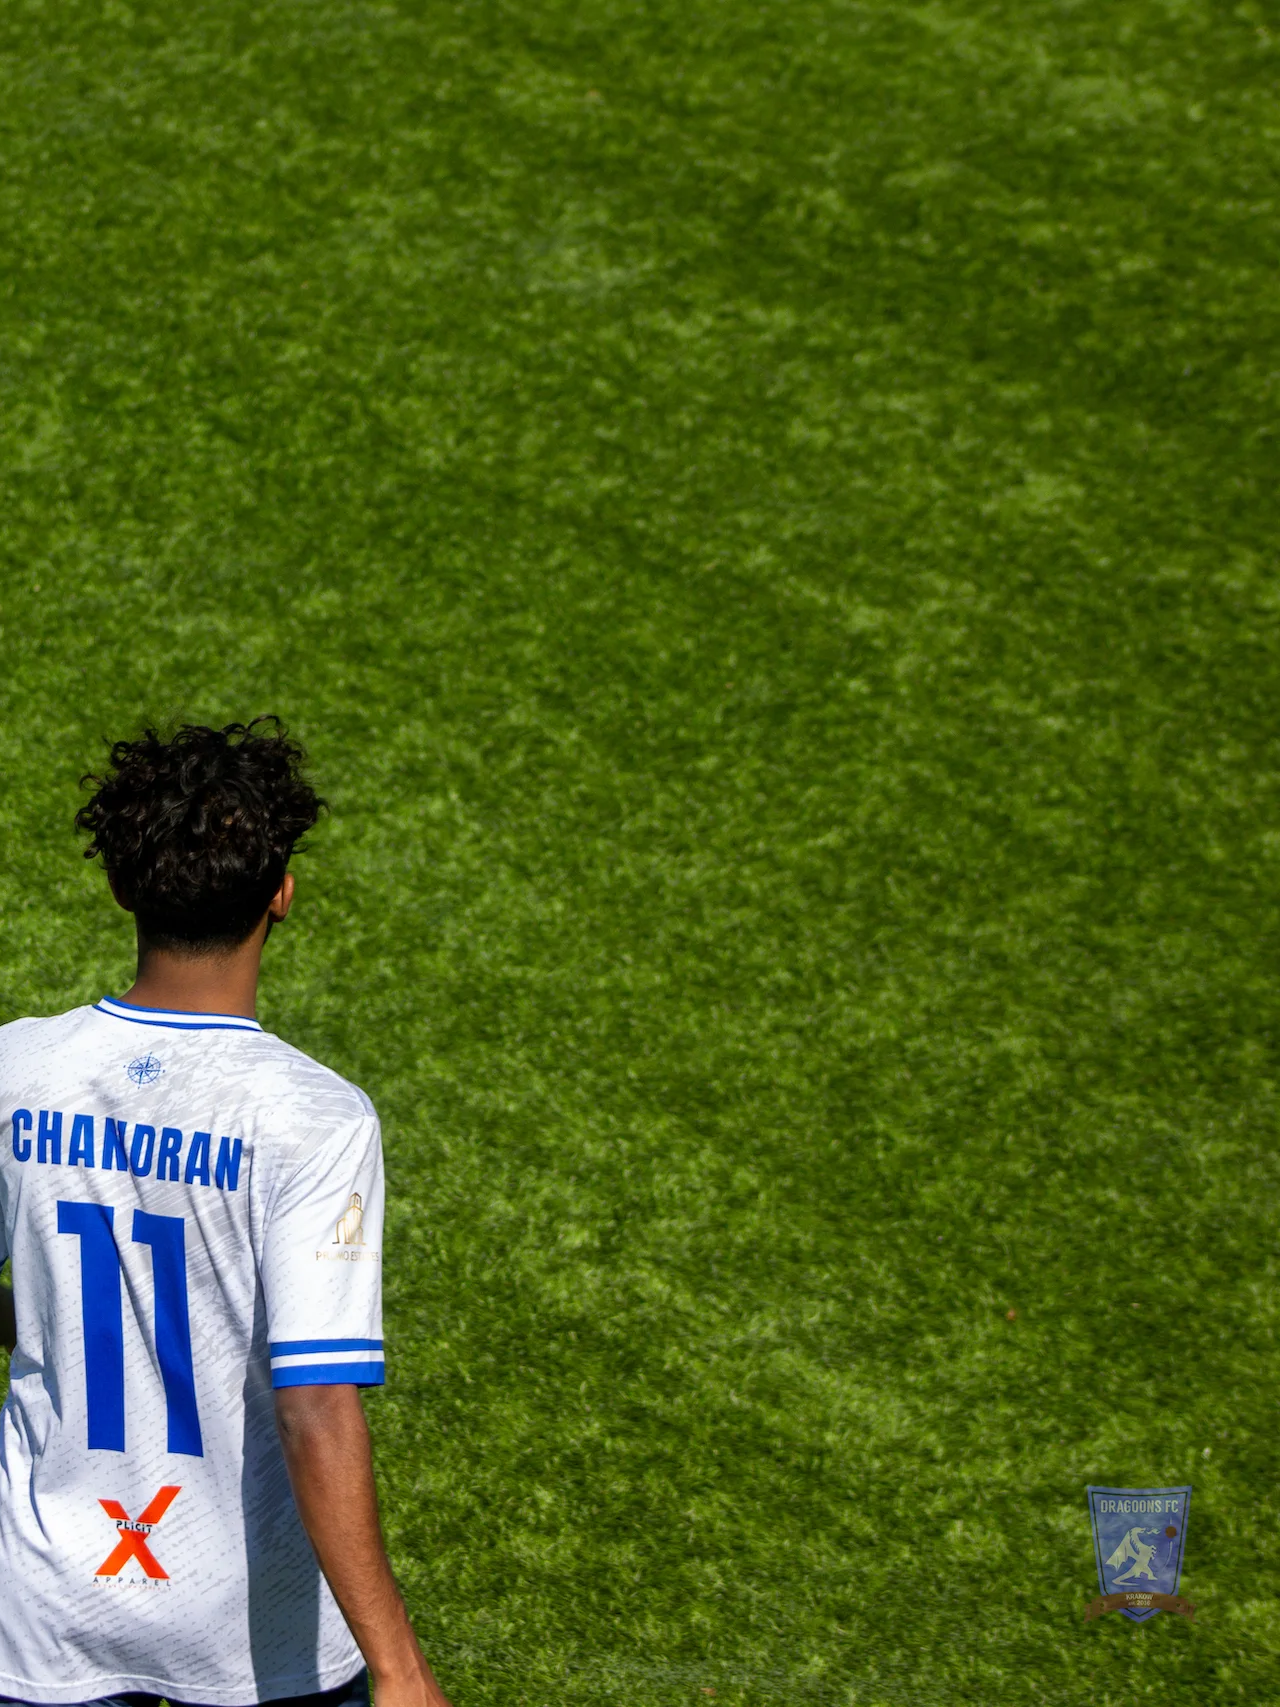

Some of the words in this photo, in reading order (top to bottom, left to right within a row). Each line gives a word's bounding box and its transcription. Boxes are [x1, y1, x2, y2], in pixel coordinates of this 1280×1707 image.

[11, 1108, 243, 1192] CHANDRAN
[56, 1200, 205, 1458] 11
[93, 1577, 172, 1587] APPAREL
